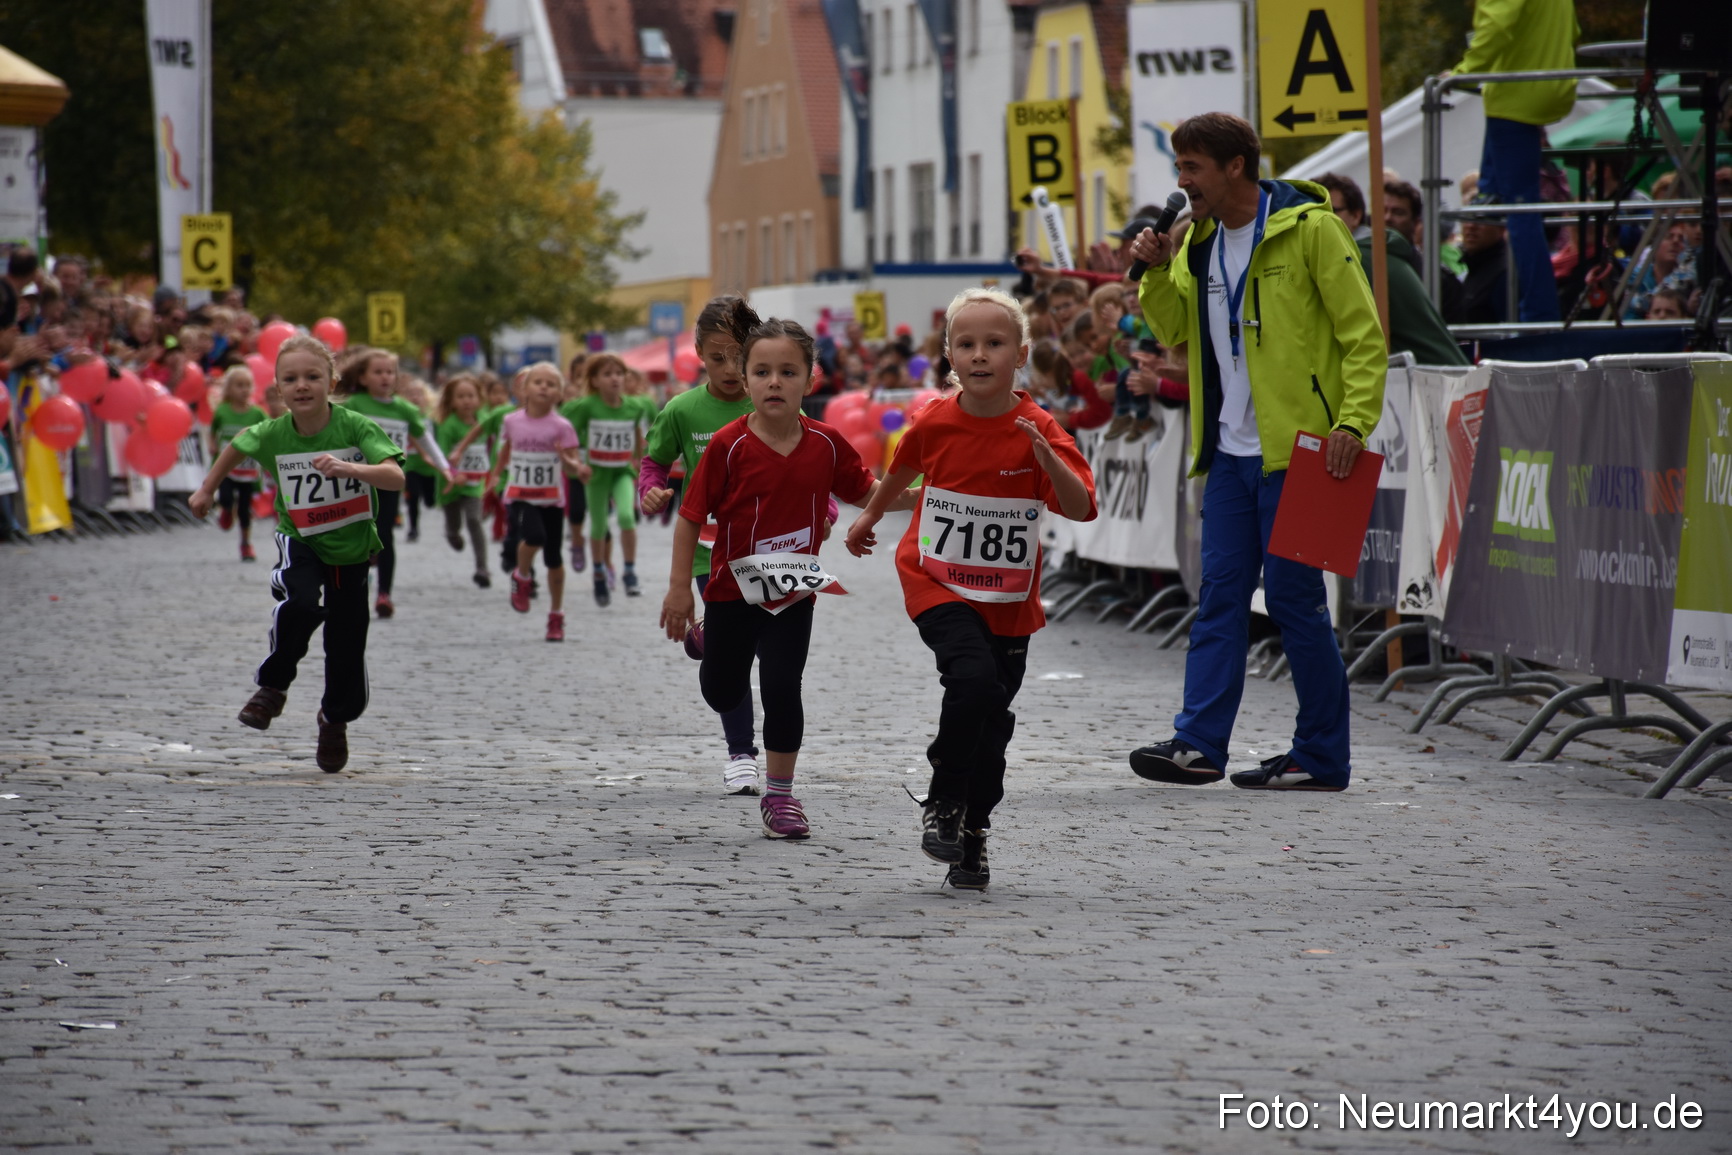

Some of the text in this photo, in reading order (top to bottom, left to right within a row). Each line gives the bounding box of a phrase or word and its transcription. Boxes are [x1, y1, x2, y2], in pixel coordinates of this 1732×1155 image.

[1286, 9, 1354, 96] A
[1015, 102, 1071, 126] Block
[1027, 134, 1062, 184] B
[193, 237, 218, 274] C
[379, 309, 396, 333] D
[862, 308, 881, 330] D
[593, 431, 631, 449] 7415
[279, 461, 307, 471] PARTL
[514, 465, 554, 486] 7181
[287, 473, 362, 504] 7214
[307, 506, 347, 524] Sophia
[926, 498, 1021, 520] PARTL Neumarkt
[770, 537, 798, 551] DEHN
[934, 515, 1028, 564] 7185
[734, 561, 808, 577] PARTL Neumarkt
[947, 567, 1004, 588] Hannah
